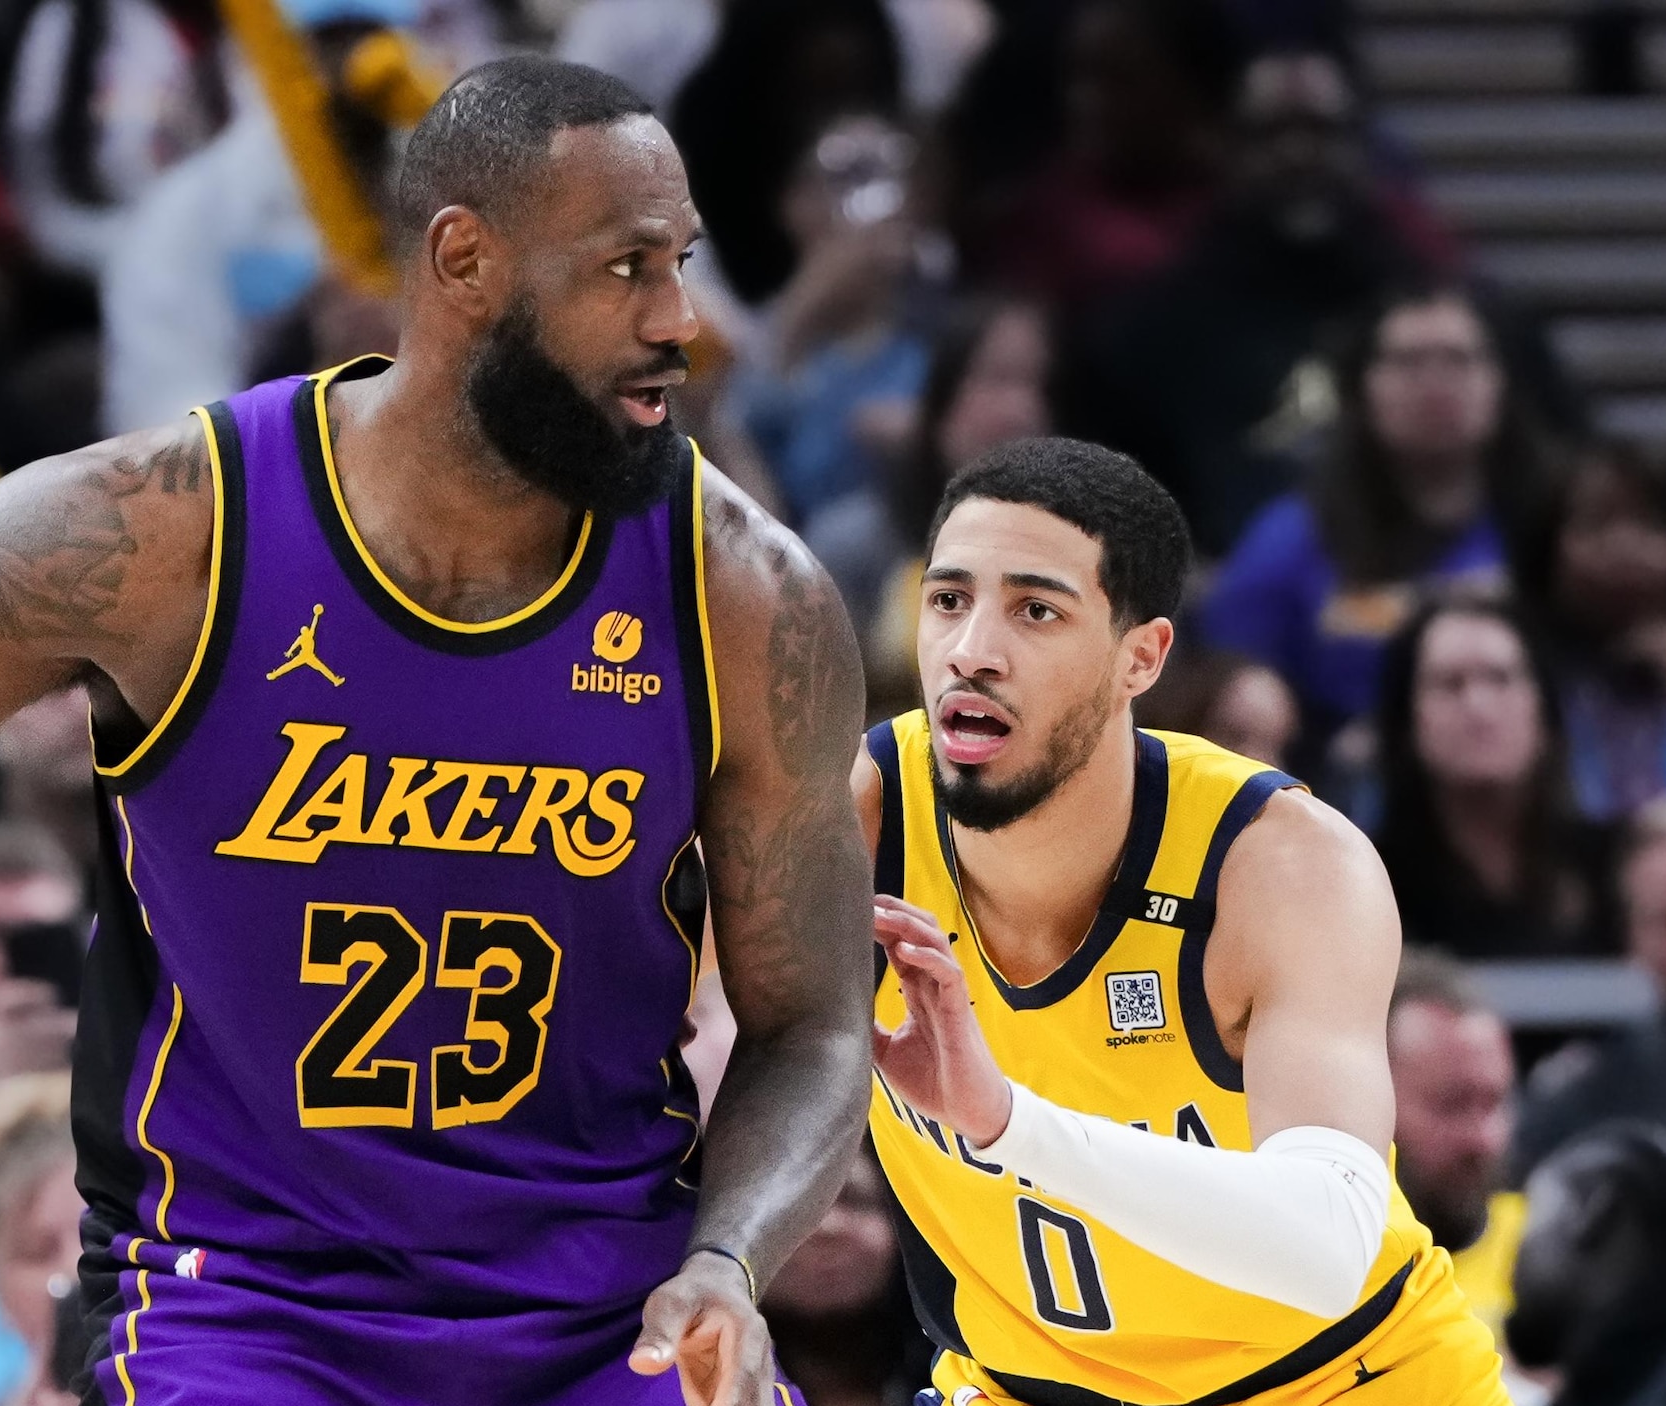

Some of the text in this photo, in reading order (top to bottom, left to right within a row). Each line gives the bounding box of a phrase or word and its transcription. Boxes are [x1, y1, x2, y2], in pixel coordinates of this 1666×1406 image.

[572, 663, 661, 704] bibigo
[214, 721, 646, 877] LAKERS
[1145, 895, 1179, 923] 30
[295, 901, 563, 1130] 23
[1105, 1032, 1176, 1050] spokenote
[1015, 1193, 1115, 1334] 0
